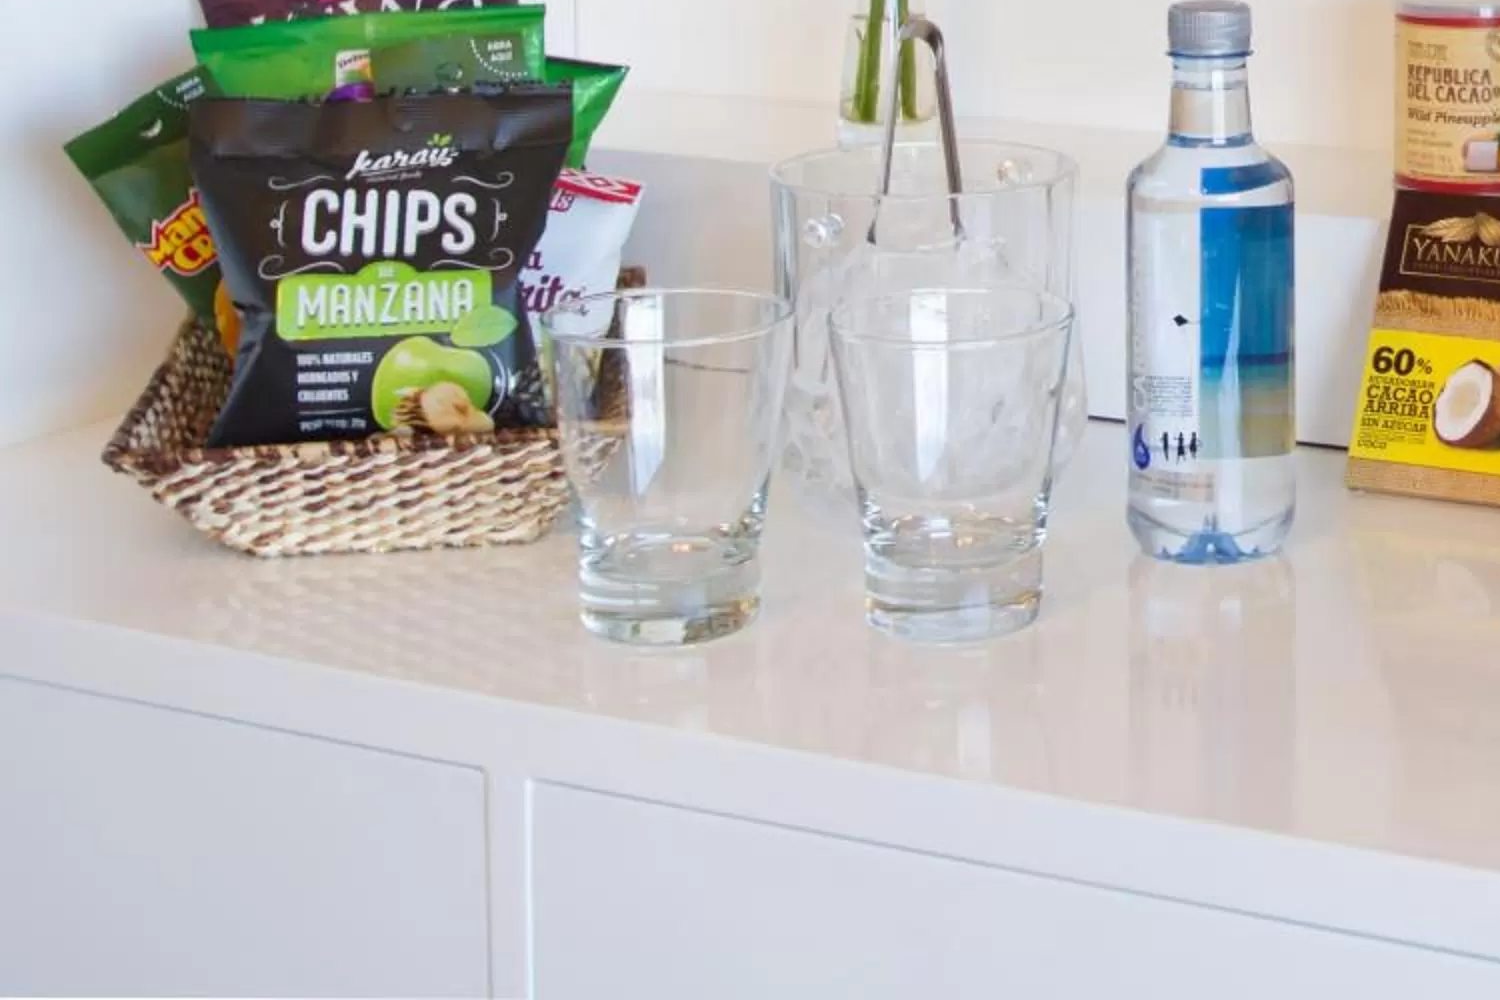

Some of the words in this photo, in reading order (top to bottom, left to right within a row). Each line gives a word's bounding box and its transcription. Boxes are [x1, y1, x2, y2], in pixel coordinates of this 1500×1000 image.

[1407, 83, 1431, 101] DEL
[1407, 107, 1431, 121] Wild
[301, 187, 477, 257] CHIPS
[296, 278, 474, 328] MANZANA
[1371, 345, 1433, 377] 60%
[1366, 383, 1434, 405] CACAO
[1363, 400, 1431, 419] ARRIBA
